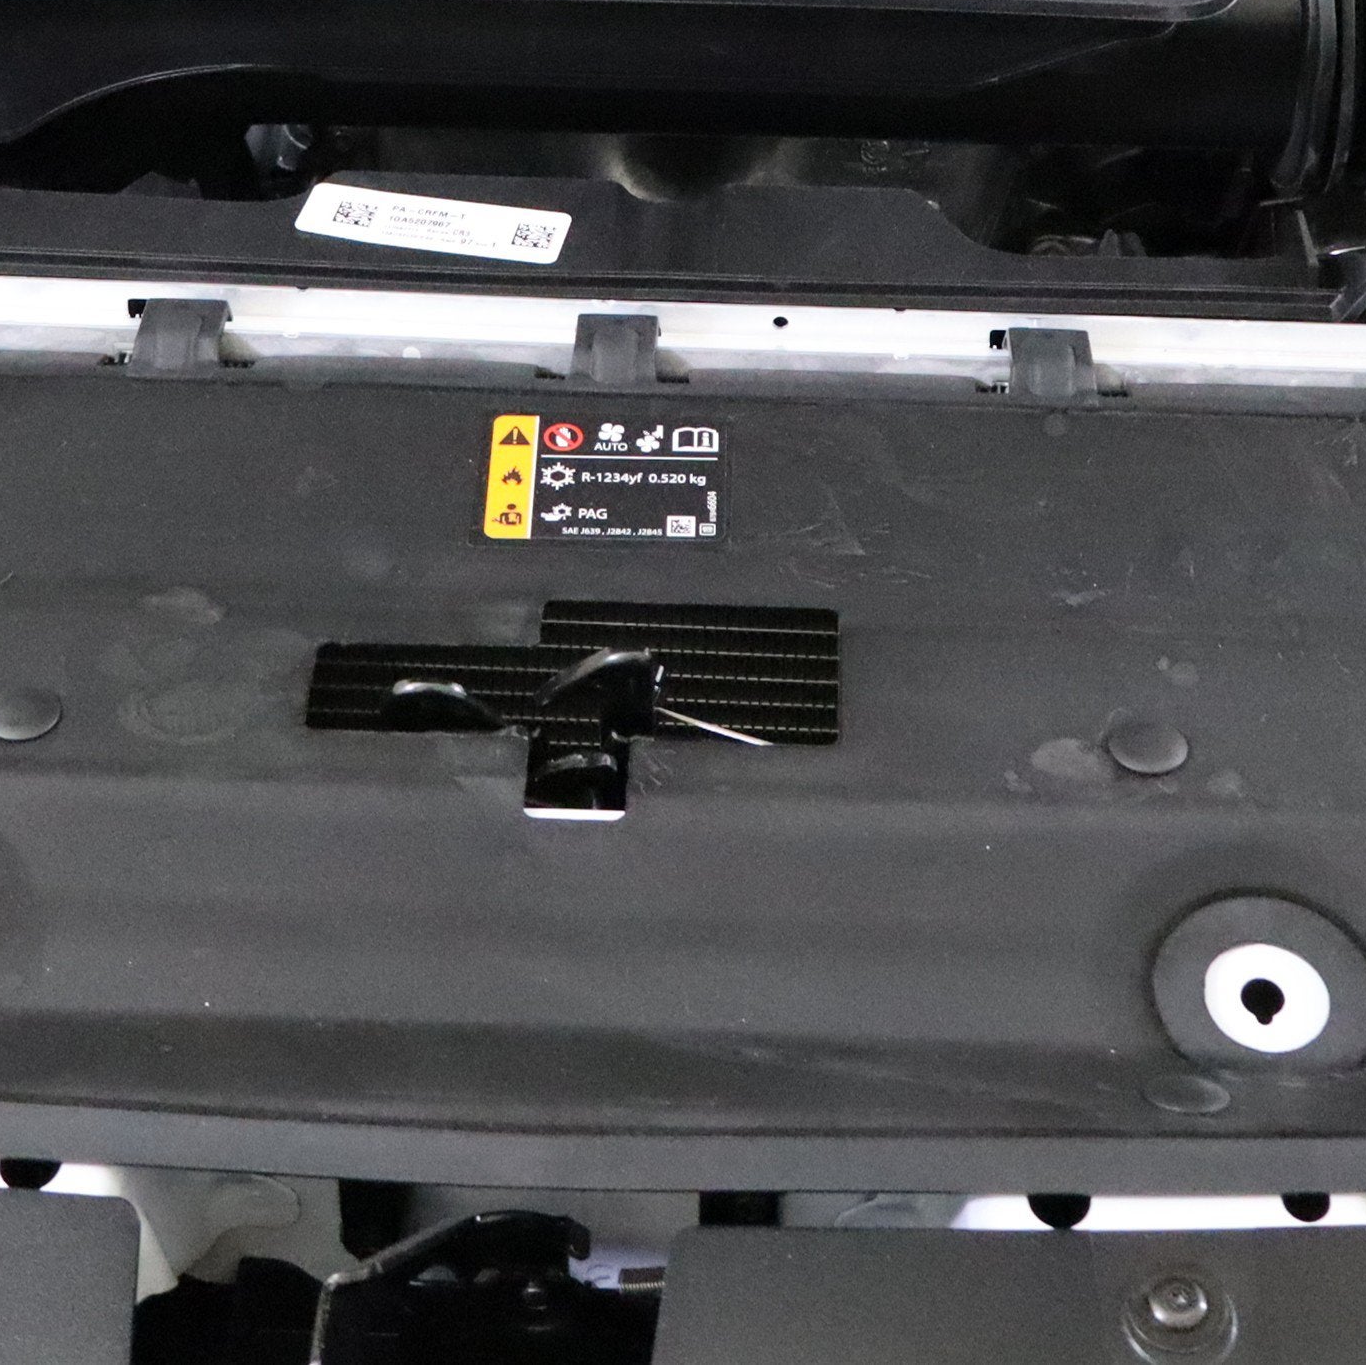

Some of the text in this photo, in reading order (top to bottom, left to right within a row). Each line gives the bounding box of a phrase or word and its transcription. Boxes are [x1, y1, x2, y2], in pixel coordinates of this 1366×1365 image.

[593, 442, 628, 451] AUTO
[581, 472, 706, 487] R-1234yf 0.520 kg
[578, 508, 608, 520] PAG
[562, 526, 579, 535] SAE
